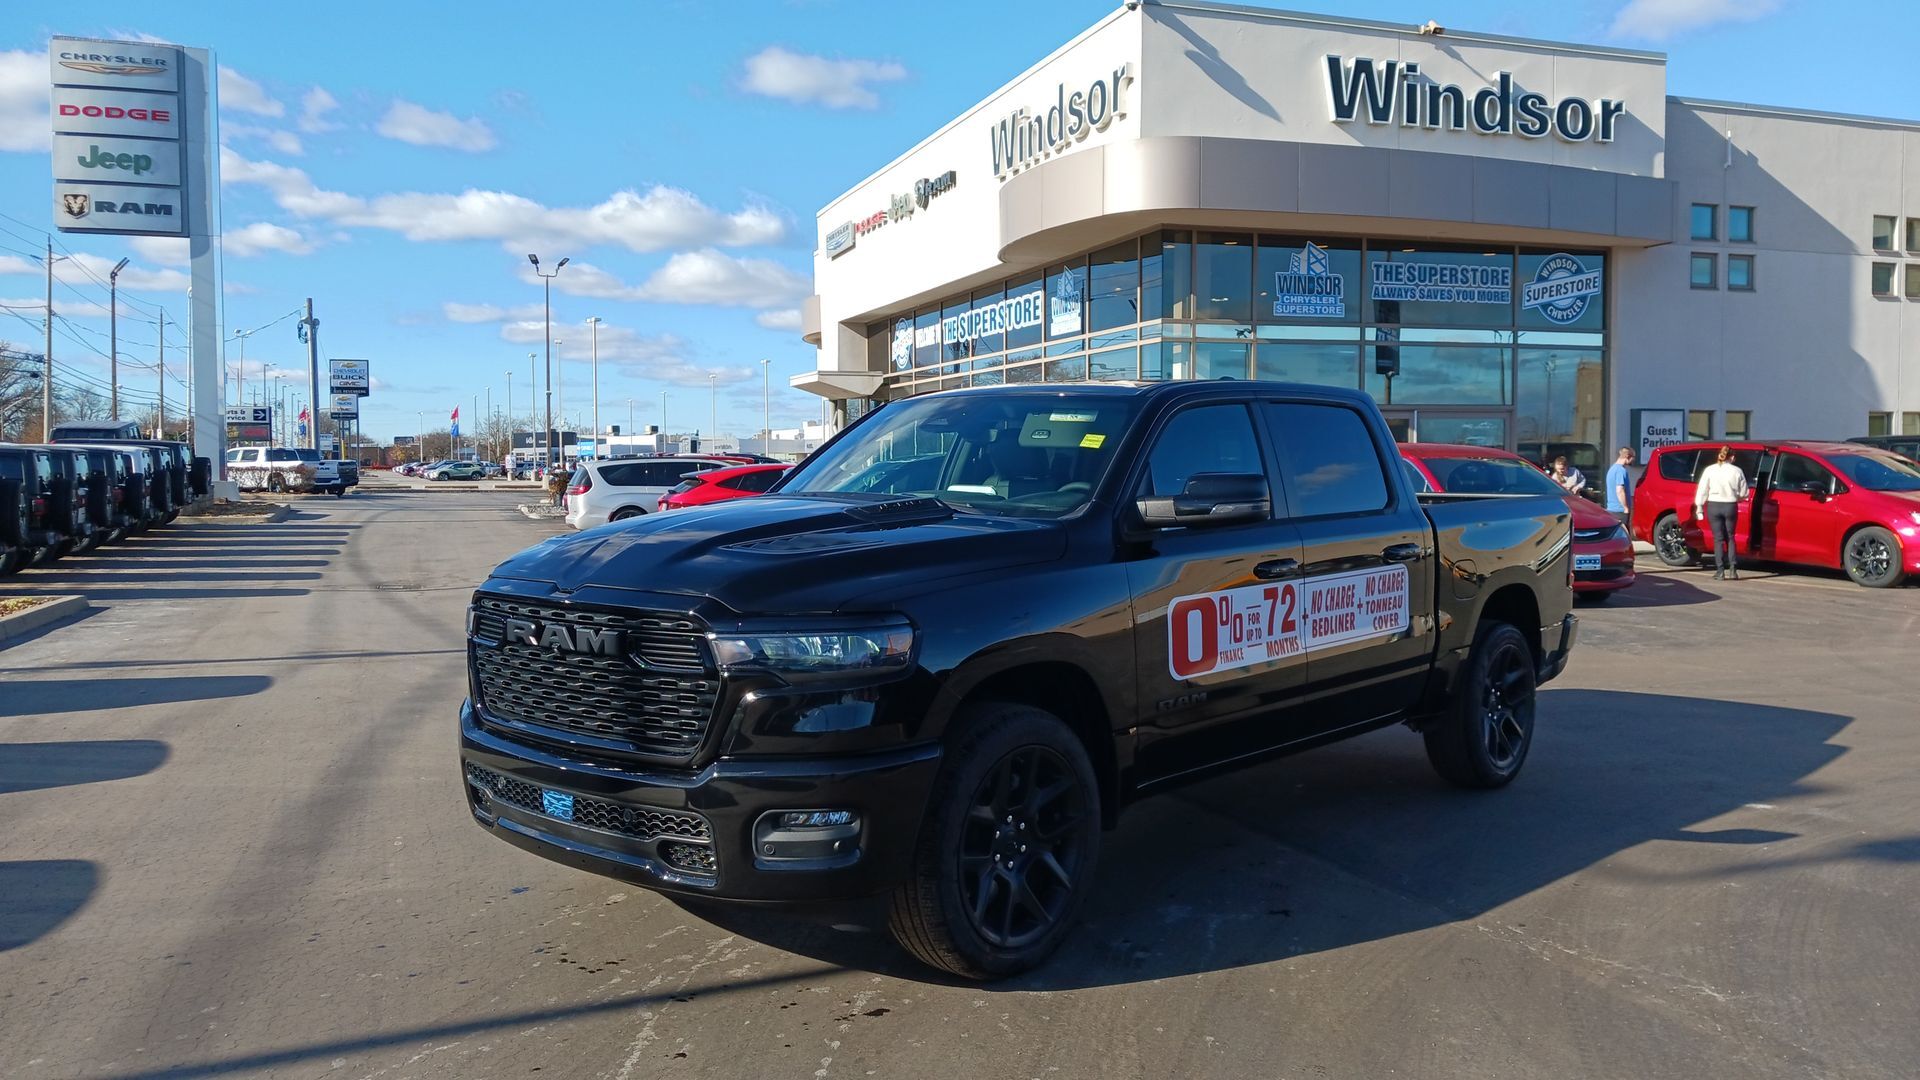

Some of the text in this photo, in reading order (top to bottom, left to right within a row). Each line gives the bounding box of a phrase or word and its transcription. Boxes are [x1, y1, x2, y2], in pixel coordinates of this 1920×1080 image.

[60, 52, 167, 66] CHRYSLER
[1321, 54, 1626, 142] Windsor
[59, 104, 171, 122] DODGE
[991, 64, 1127, 176] Windsor
[77, 145, 152, 175] Jeep
[925, 170, 957, 194] RAM
[94, 200, 173, 216] RAM
[1373, 264, 1510, 286] THE SUPERSTORE
[1541, 258, 1578, 278] WINDSOR
[1277, 275, 1341, 296] WINDSOR
[1373, 286, 1510, 302] ALWAYS SAVES YOU MORE!
[1526, 276, 1599, 302] SUPERSTORE
[1276, 305, 1343, 314] SUPERSTORE
[1283, 295, 1335, 304] CHRYSLER
[1547, 299, 1584, 320] CHRYSLER
[943, 320, 958, 341] THE
[959, 294, 1041, 342] SUPERSTORE
[1647, 425, 1678, 436] Guest
[1642, 437, 1682, 448] Parking
[1365, 571, 1404, 597] NO CHARGE
[1311, 584, 1355, 614] NO CHARGE
[1366, 594, 1404, 615] TONNEAU
[1247, 612, 1261, 626] FOR
[1263, 583, 1297, 637] 72
[1312, 611, 1355, 638] BEDLINER
[1373, 612, 1399, 630] COVER
[506, 618, 621, 654] RAM
[1171, 595, 1244, 677] 0%
[1246, 627, 1263, 642] UP TO
[1219, 647, 1244, 664] FINANCE
[1266, 635, 1300, 658] MONTHS
